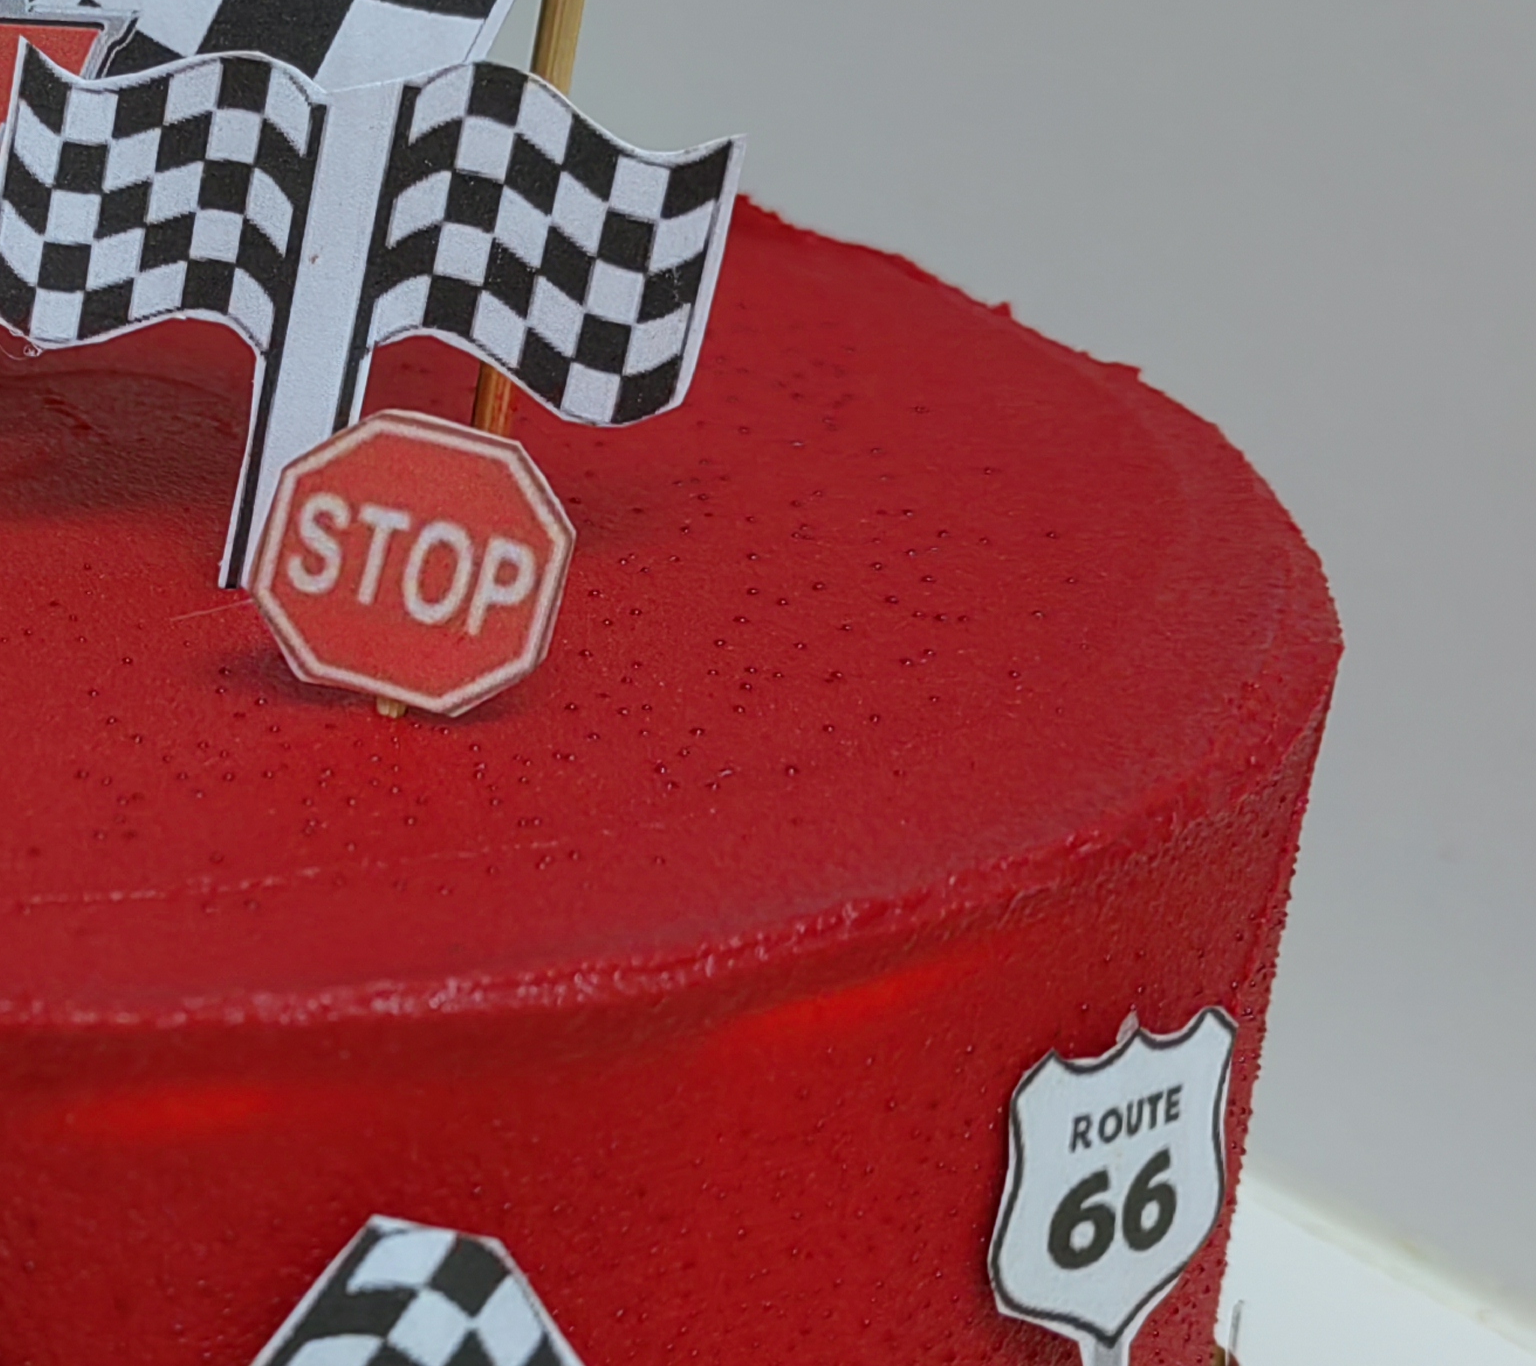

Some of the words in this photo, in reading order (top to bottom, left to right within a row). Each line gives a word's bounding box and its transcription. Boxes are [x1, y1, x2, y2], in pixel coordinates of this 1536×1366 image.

[286, 492, 537, 636] STOP
[1069, 1084, 1183, 1153] ROUTE
[1047, 1146, 1177, 1270] 66
